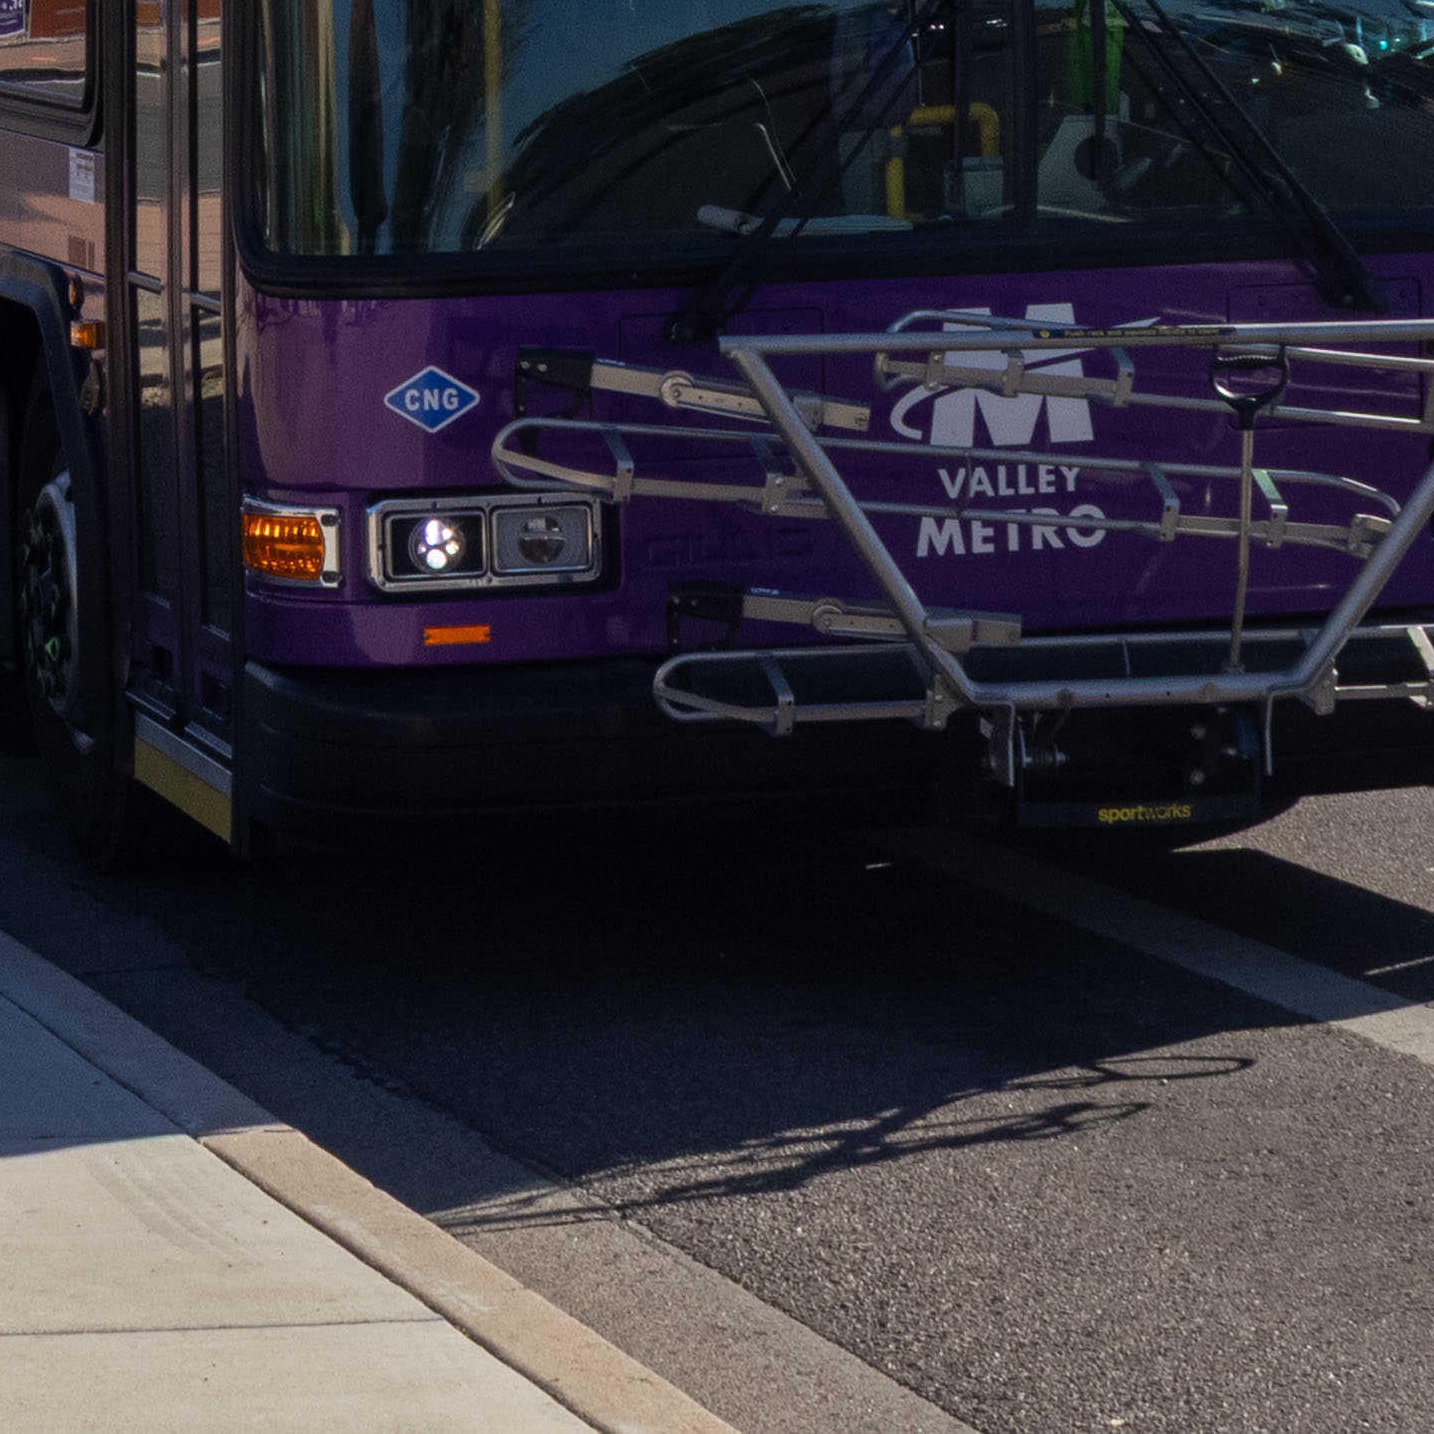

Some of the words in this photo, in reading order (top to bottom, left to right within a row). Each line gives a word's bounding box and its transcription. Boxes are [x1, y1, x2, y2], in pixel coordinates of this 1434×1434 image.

[405, 388, 459, 411] CNG
[937, 464, 1081, 500] VALLEY
[916, 504, 1107, 558] METRO
[1097, 803, 1192, 825] sportworks
